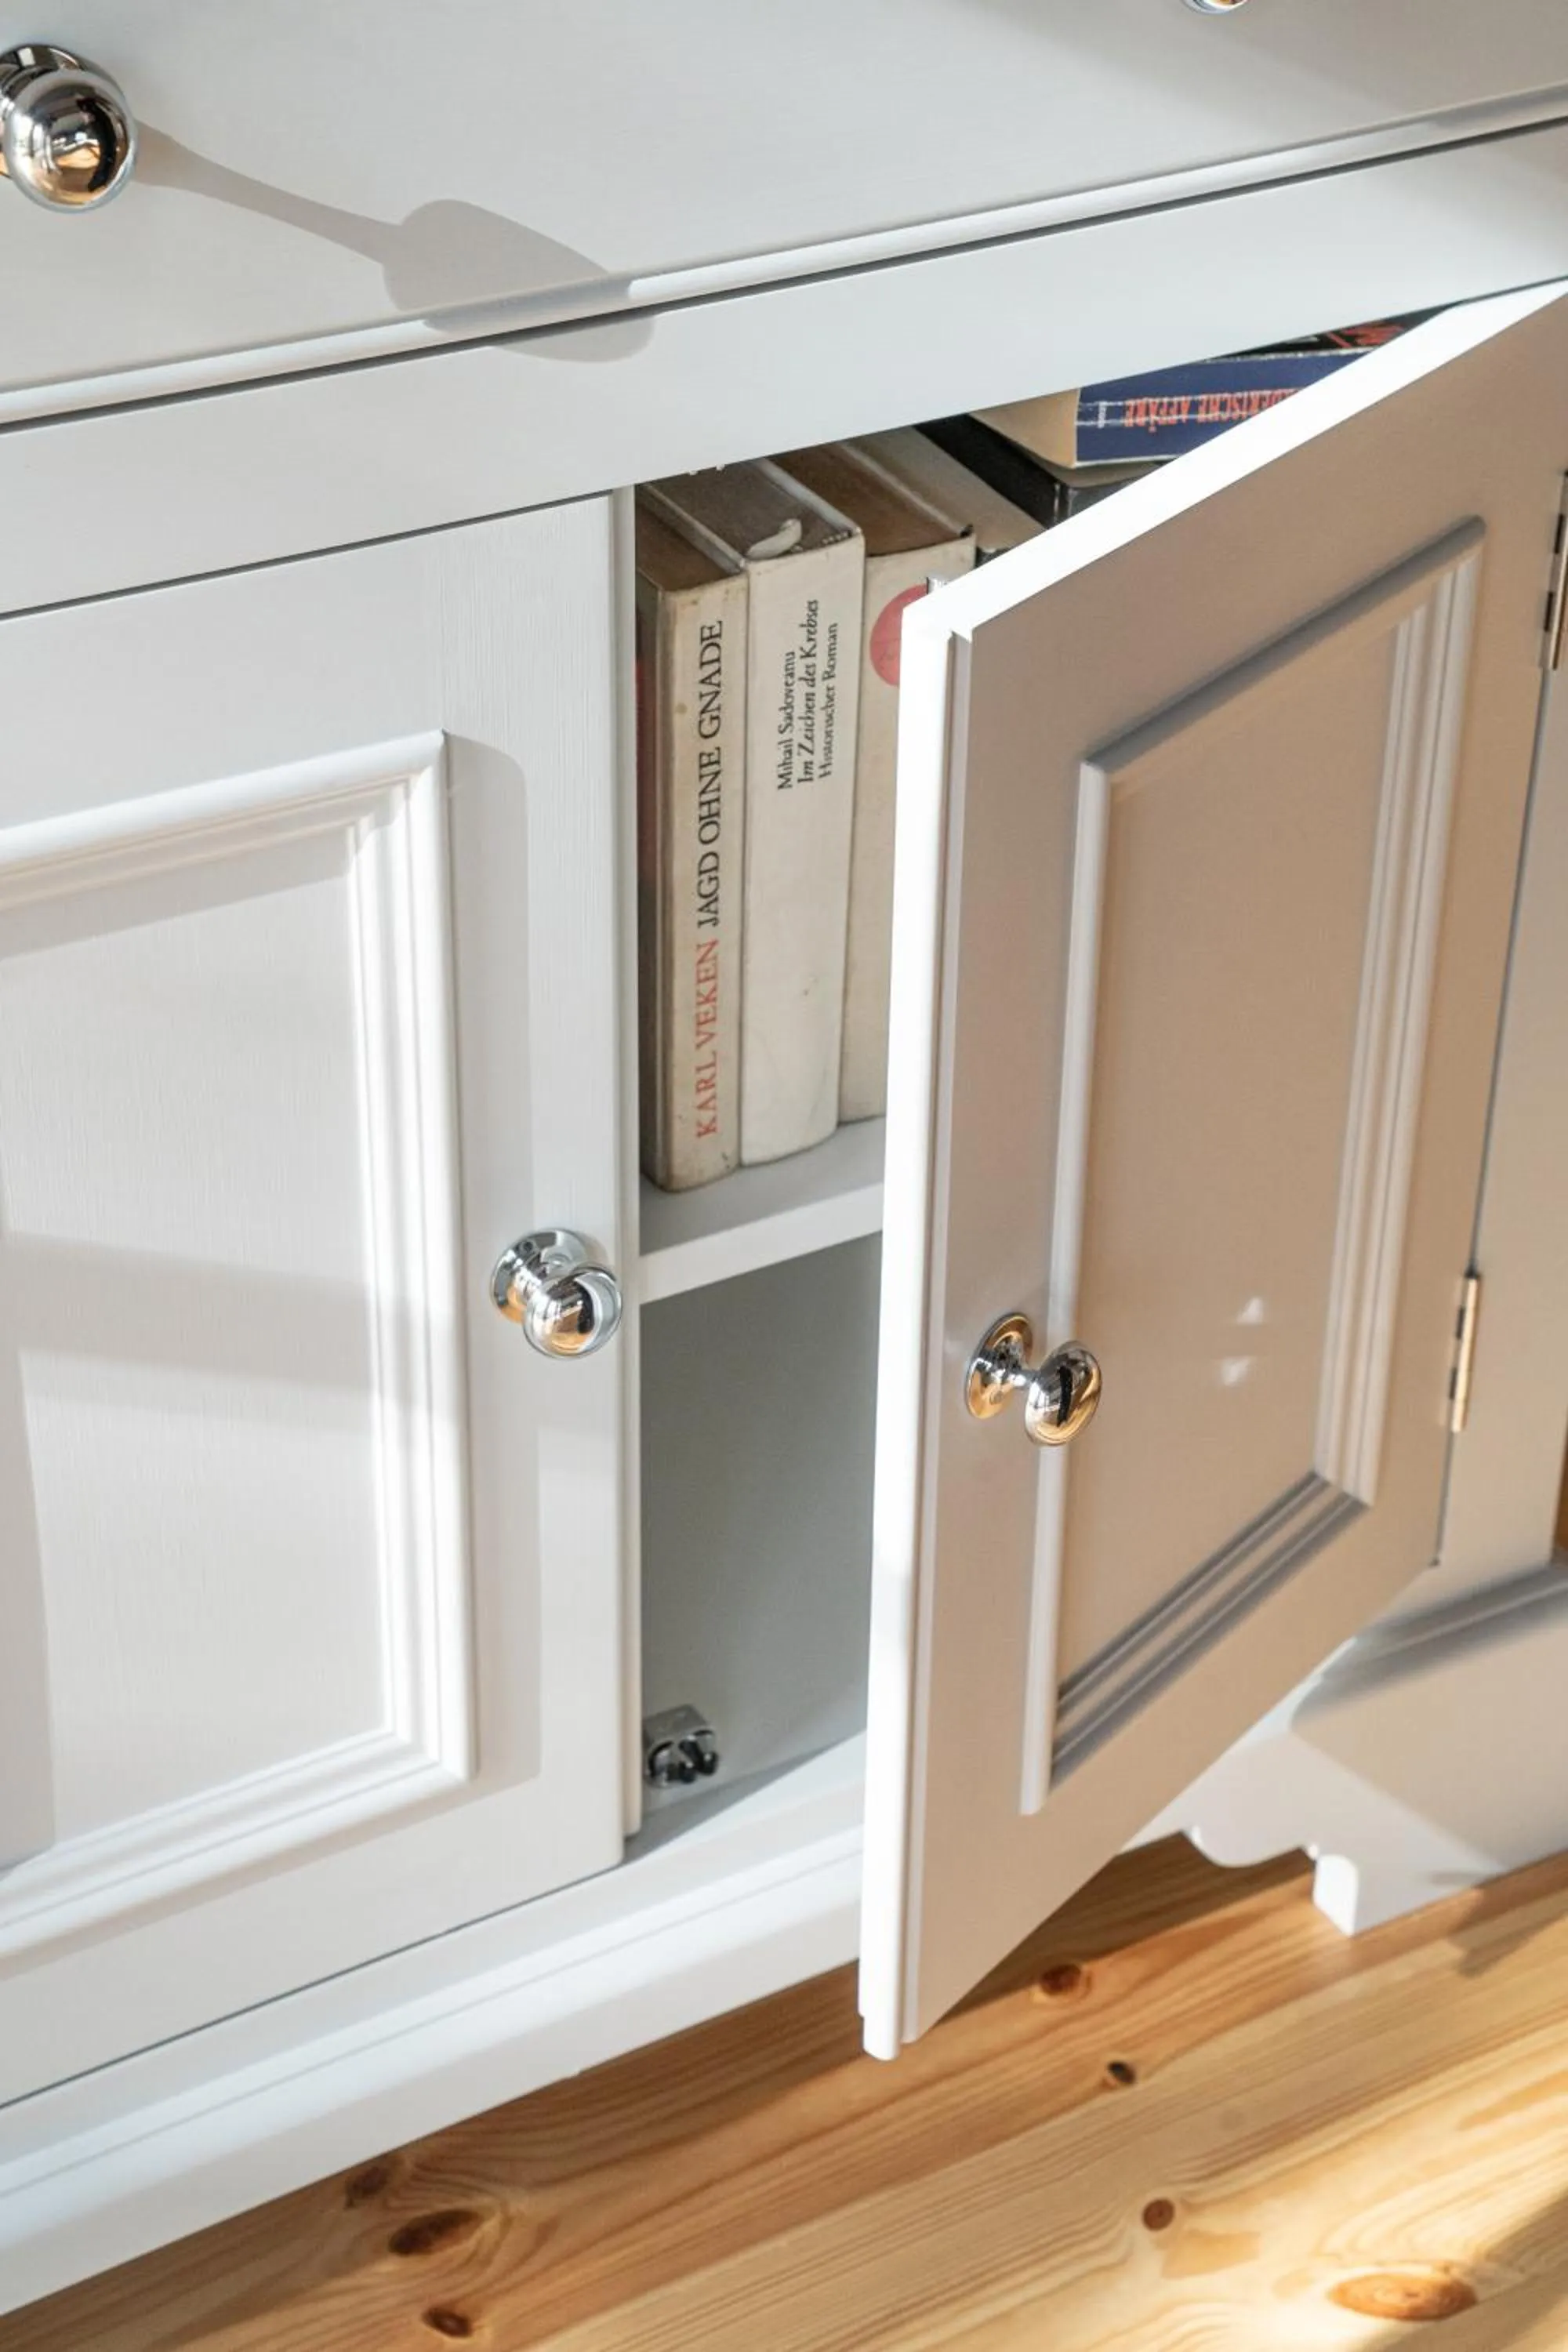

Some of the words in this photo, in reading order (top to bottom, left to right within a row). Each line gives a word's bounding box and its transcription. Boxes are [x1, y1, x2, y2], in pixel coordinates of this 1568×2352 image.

[799, 598, 819, 660] Krebses
[821, 622, 838, 681] Roman
[698, 619, 723, 739] GNADE
[777, 651, 796, 735] Sadoveanu
[797, 662, 817, 688] des
[797, 691, 816, 756] Zeichen
[818, 684, 837, 779] Historischer
[697, 746, 722, 846] OHNE
[777, 737, 793, 790] Mihail
[797, 759, 815, 784] Im
[695, 851, 720, 928] JAGD
[695, 938, 720, 1051] VEKEN
[695, 1051, 717, 1139] KARL
